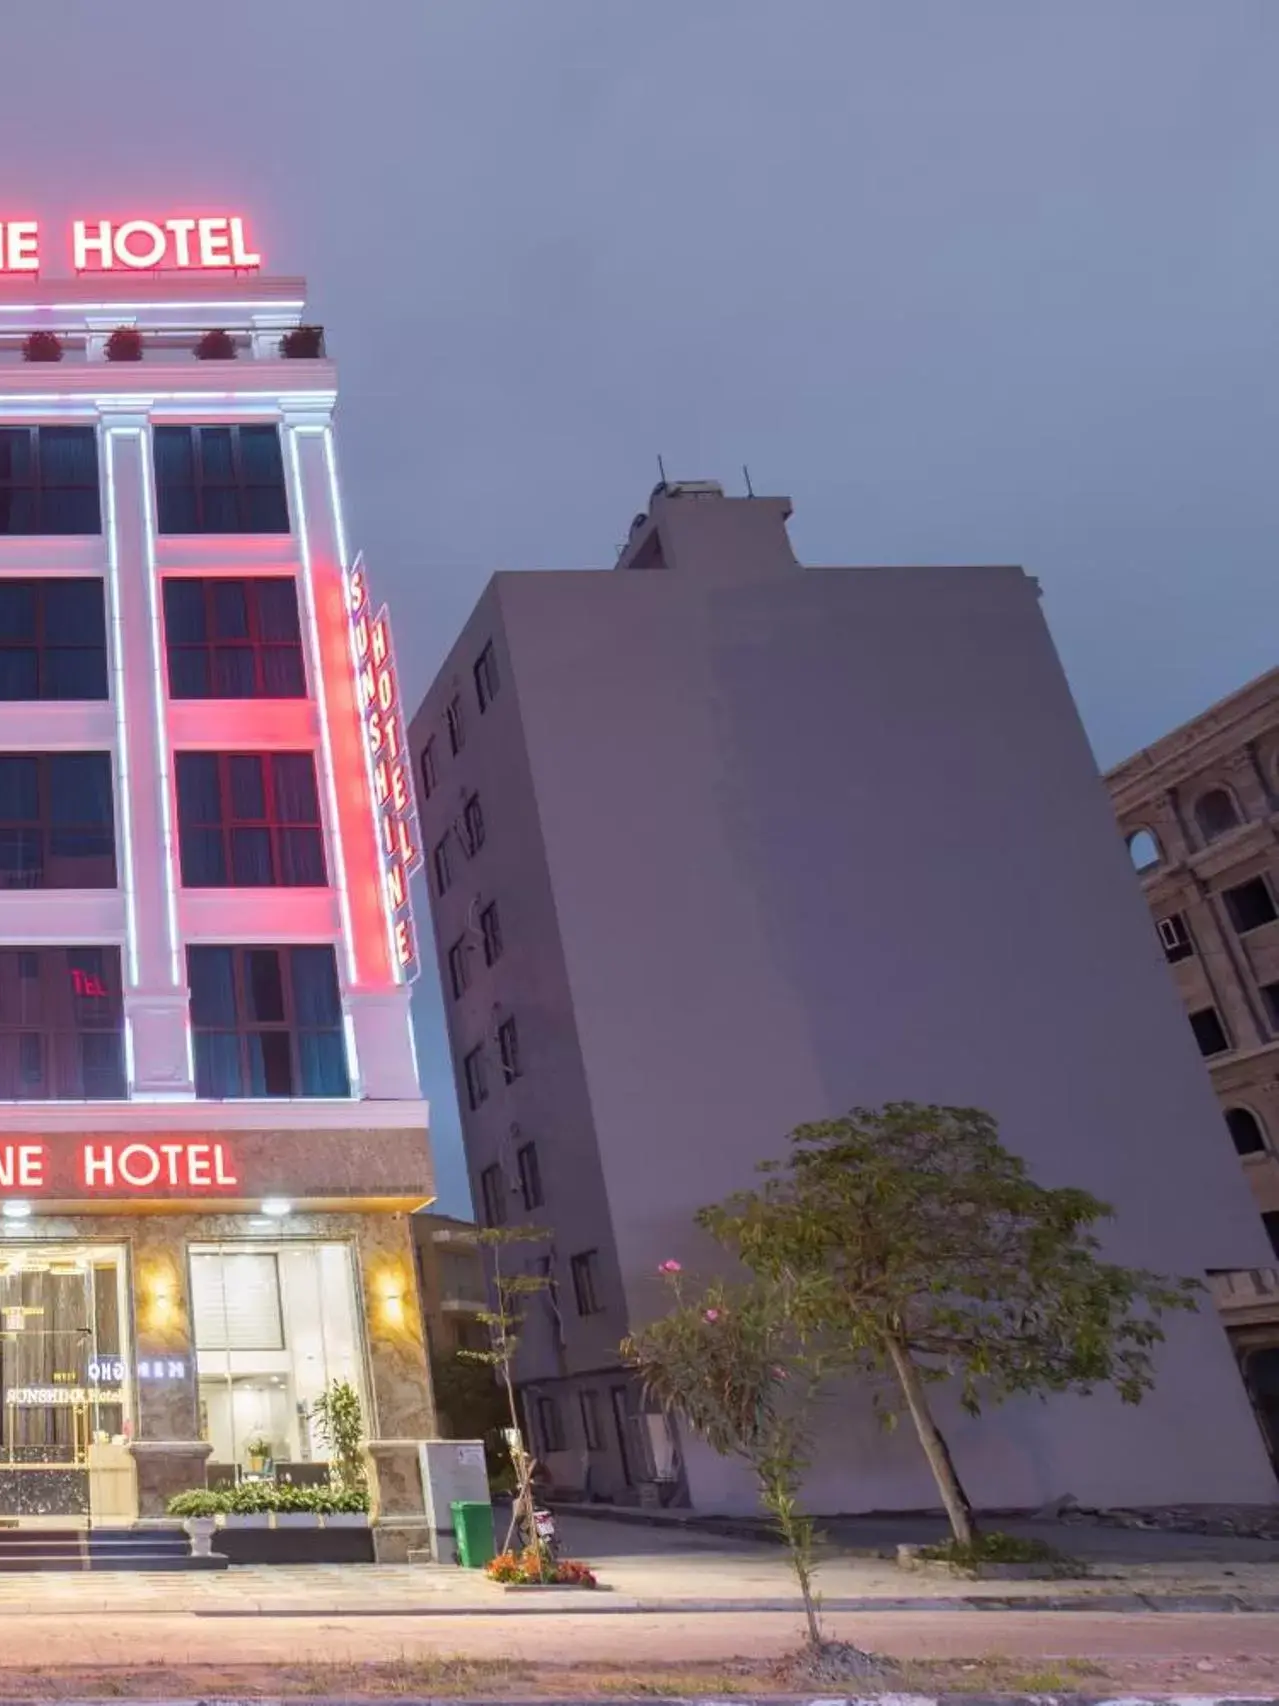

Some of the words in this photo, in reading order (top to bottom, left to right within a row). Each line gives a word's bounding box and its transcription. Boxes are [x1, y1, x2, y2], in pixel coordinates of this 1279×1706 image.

[73, 217, 261, 268] HOTEL
[350, 571, 412, 967] SUNSHINE
[371, 620, 414, 866] HOTEL
[83, 1143, 237, 1187] HOTEL
